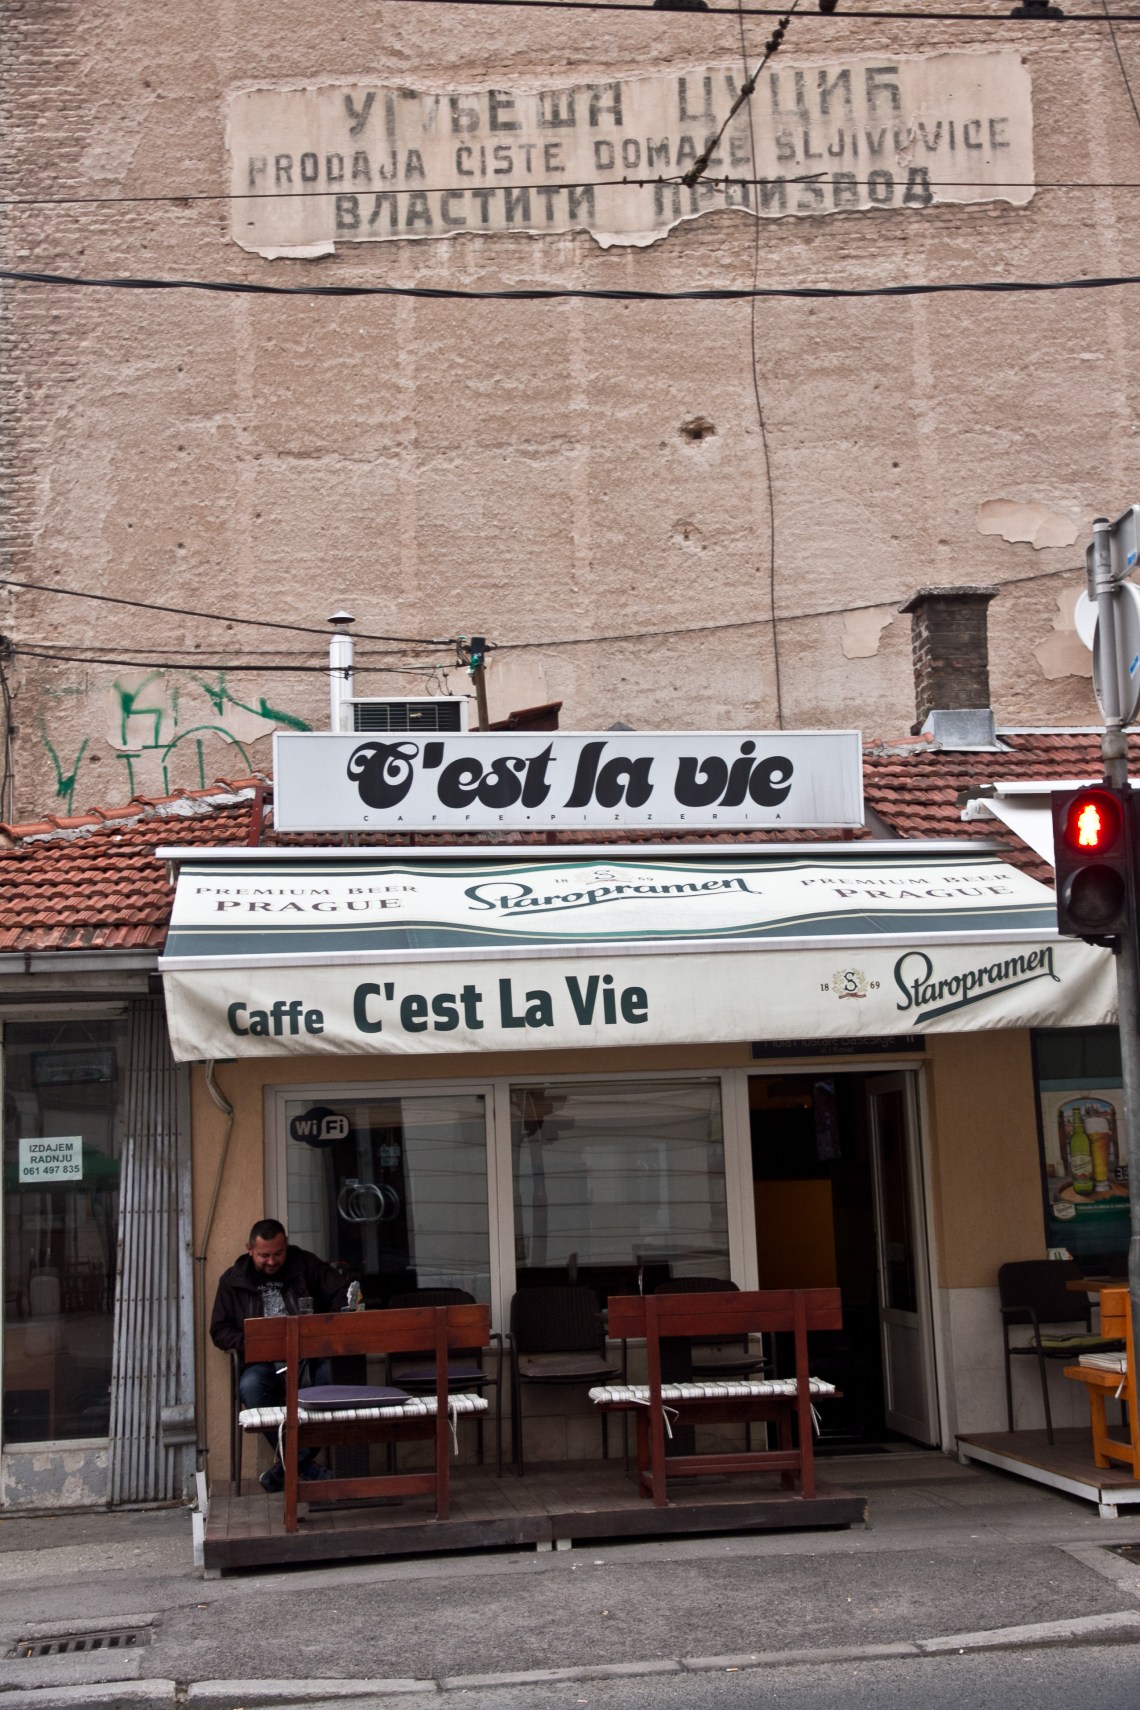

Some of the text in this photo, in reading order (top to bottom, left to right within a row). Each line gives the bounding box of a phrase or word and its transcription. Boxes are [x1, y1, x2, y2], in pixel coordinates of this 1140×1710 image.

[248, 149, 426, 185] PRODAJA
[335, 186, 597, 230] ВЛАСТИТИ
[347, 741, 556, 809] C'est
[564, 741, 654, 808] la
[674, 740, 794, 807] vie
[800, 873, 1012, 887] PREMIUM BEER
[195, 884, 418, 896] PREMIUM BEER
[464, 877, 760, 914] Staropramen
[833, 885, 1015, 900] PRAGUE
[215, 898, 403, 912] PRAGUE
[820, 983, 830, 992] 18
[869, 980, 881, 990] 69
[894, 946, 1058, 1017] Staropramen
[227, 974, 649, 1037] Caffe C'est La Vie
[29, 1142, 74, 1153] IZDAJEM
[30, 1153, 73, 1164] RADNJU
[23, 1164, 80, 1176] 061 497 835
